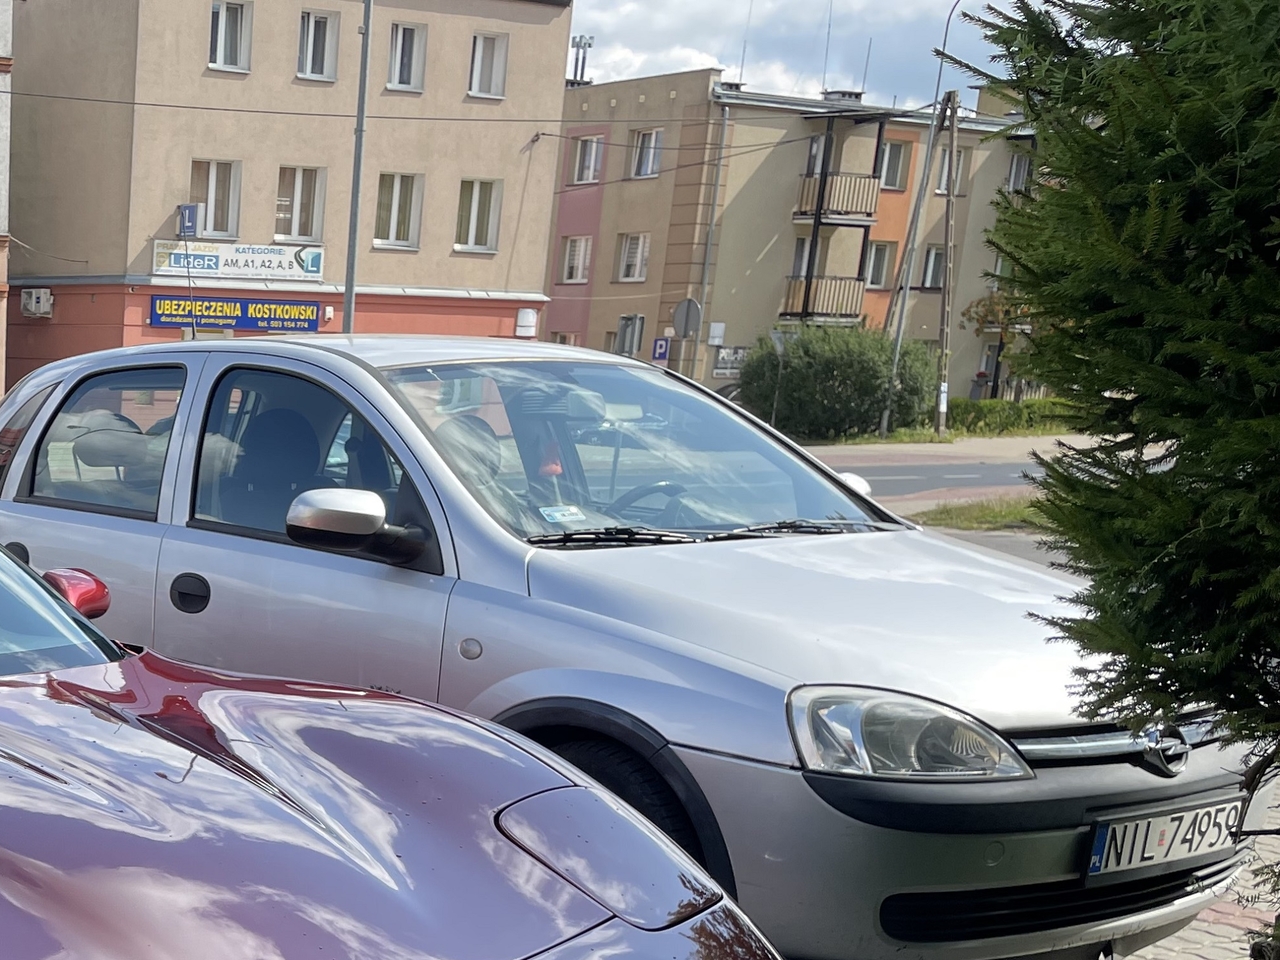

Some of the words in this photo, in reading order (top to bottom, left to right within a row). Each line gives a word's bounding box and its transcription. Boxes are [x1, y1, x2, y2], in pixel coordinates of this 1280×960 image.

[235, 247, 286, 255] KATEGORIE:
[170, 254, 217, 269] LideR
[288, 260, 294, 270] B
[156, 300, 242, 317] UBEZPIECZENIA
[248, 303, 317, 320] KOSTKOWSKI
[655, 340, 666, 358] P
[1090, 855, 1101, 868] PL
[1103, 818, 1155, 870] NIL
